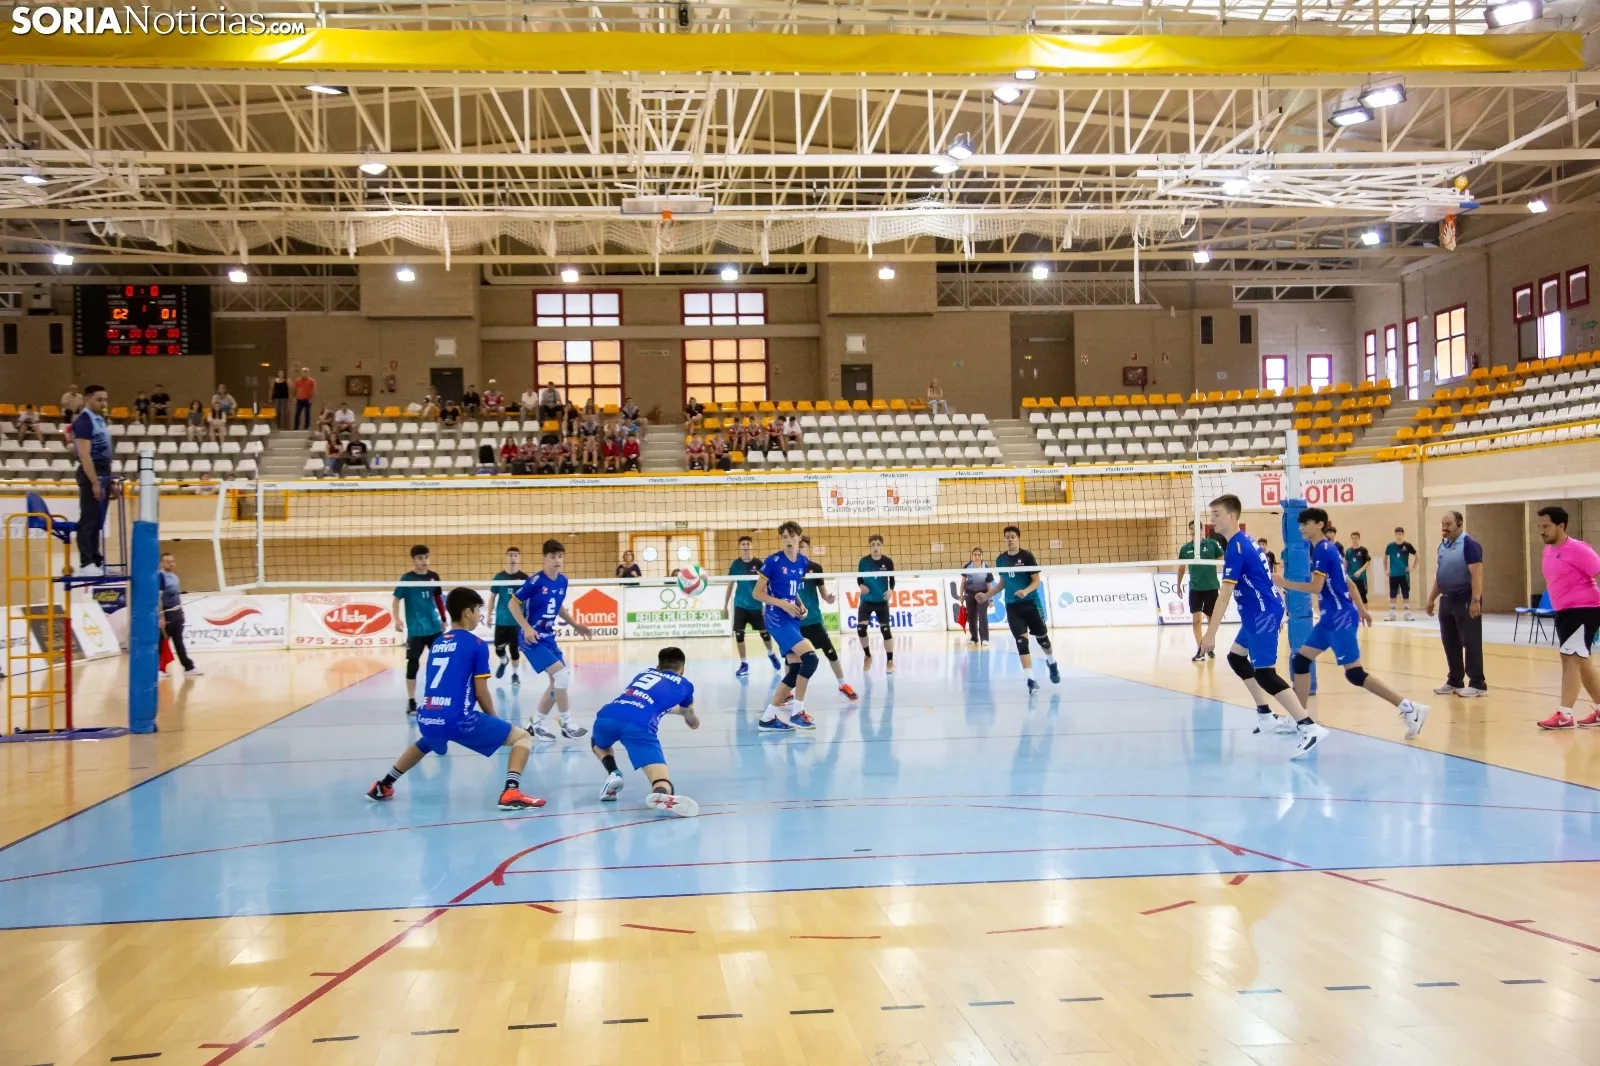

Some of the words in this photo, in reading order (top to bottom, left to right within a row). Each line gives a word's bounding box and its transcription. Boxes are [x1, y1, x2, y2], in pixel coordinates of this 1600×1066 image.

[1305, 477, 1354, 485] AYUNTAMIENTO
[1300, 483, 1355, 504] oria
[789, 579, 797, 596] 11
[1076, 591, 1148, 604] camaretas
[546, 597, 557, 615] 2
[576, 608, 617, 624] home
[637, 621, 661, 630] Ahorra
[679, 621, 710, 629] nosotros
[295, 636, 325, 644] 975
[331, 637, 349, 645] 22
[354, 637, 373, 646] 03
[380, 637, 397, 645] 51
[431, 642, 458, 654] DAVID
[429, 656, 450, 689] 7
[632, 673, 662, 691] 9
